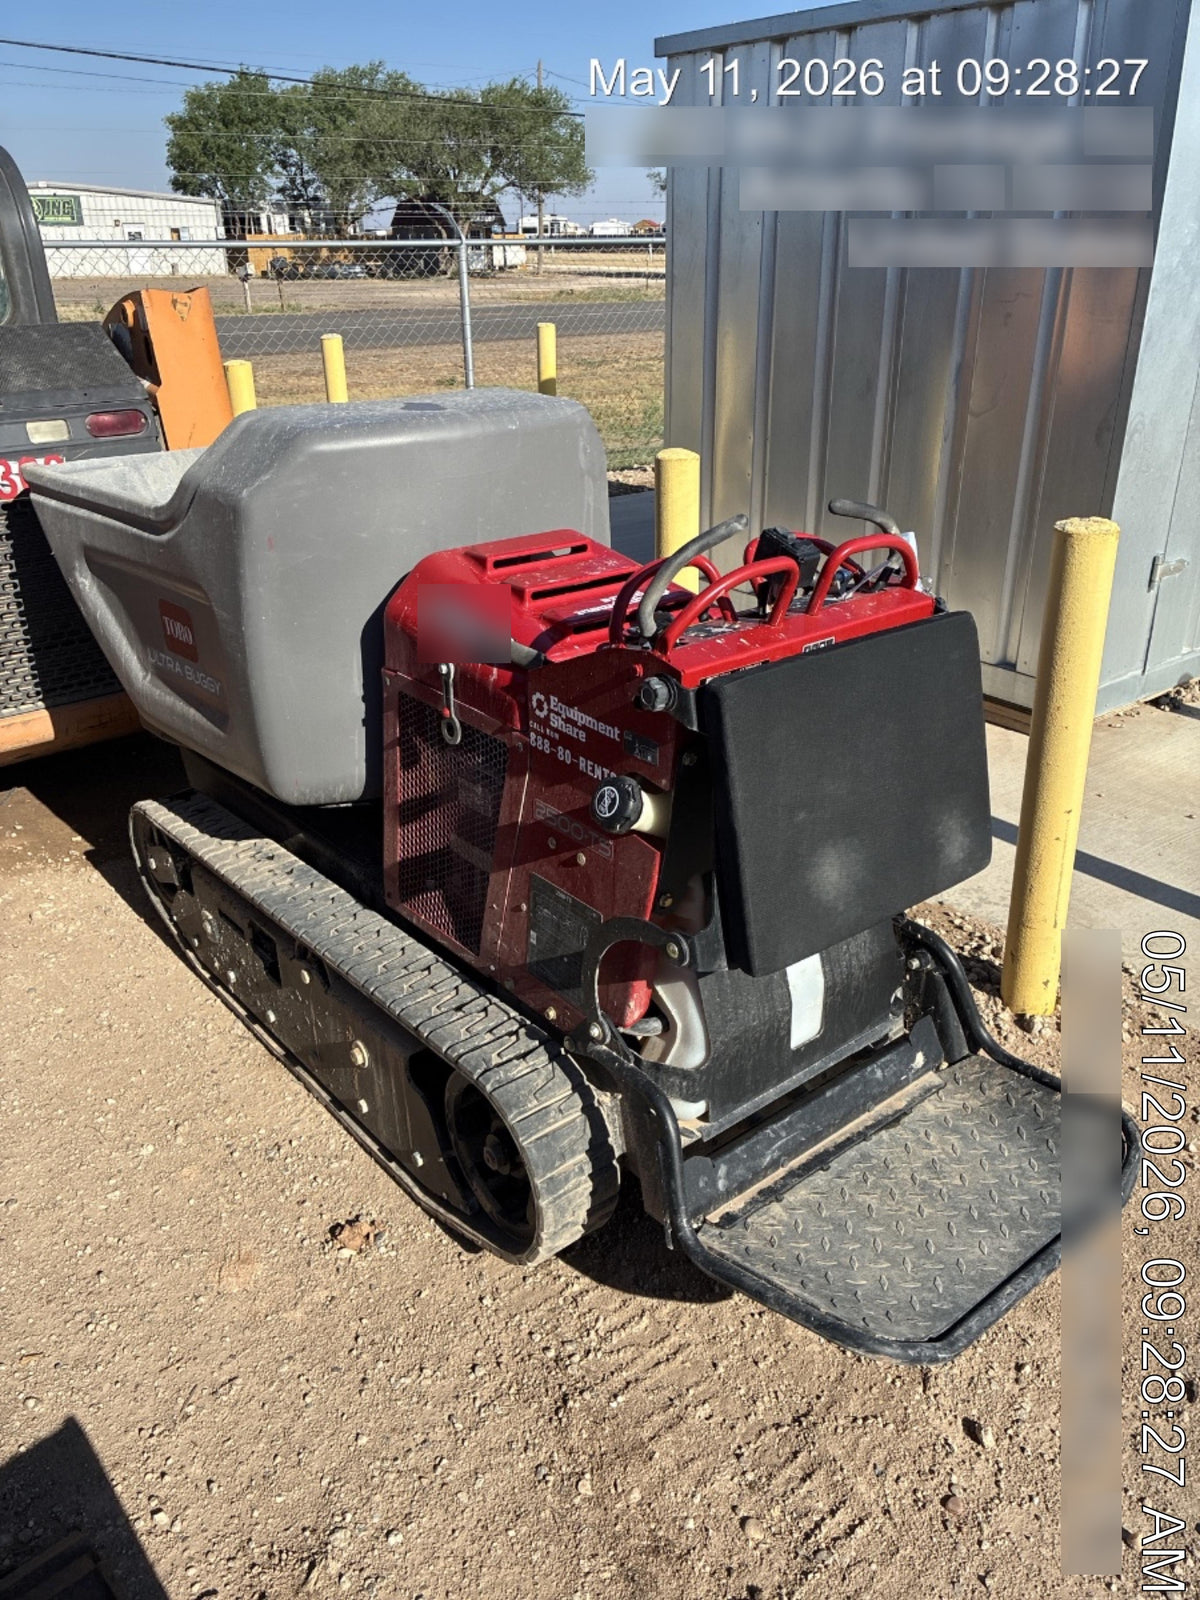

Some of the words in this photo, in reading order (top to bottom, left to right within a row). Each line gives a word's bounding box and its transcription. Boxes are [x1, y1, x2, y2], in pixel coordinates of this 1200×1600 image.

[162, 616, 193, 645] TORO
[147, 647, 184, 677] ULTRA
[184, 664, 221, 697] BUGGY
[529, 720, 544, 734] CALL
[549, 695, 621, 742] Equipment
[549, 712, 587, 743] Share
